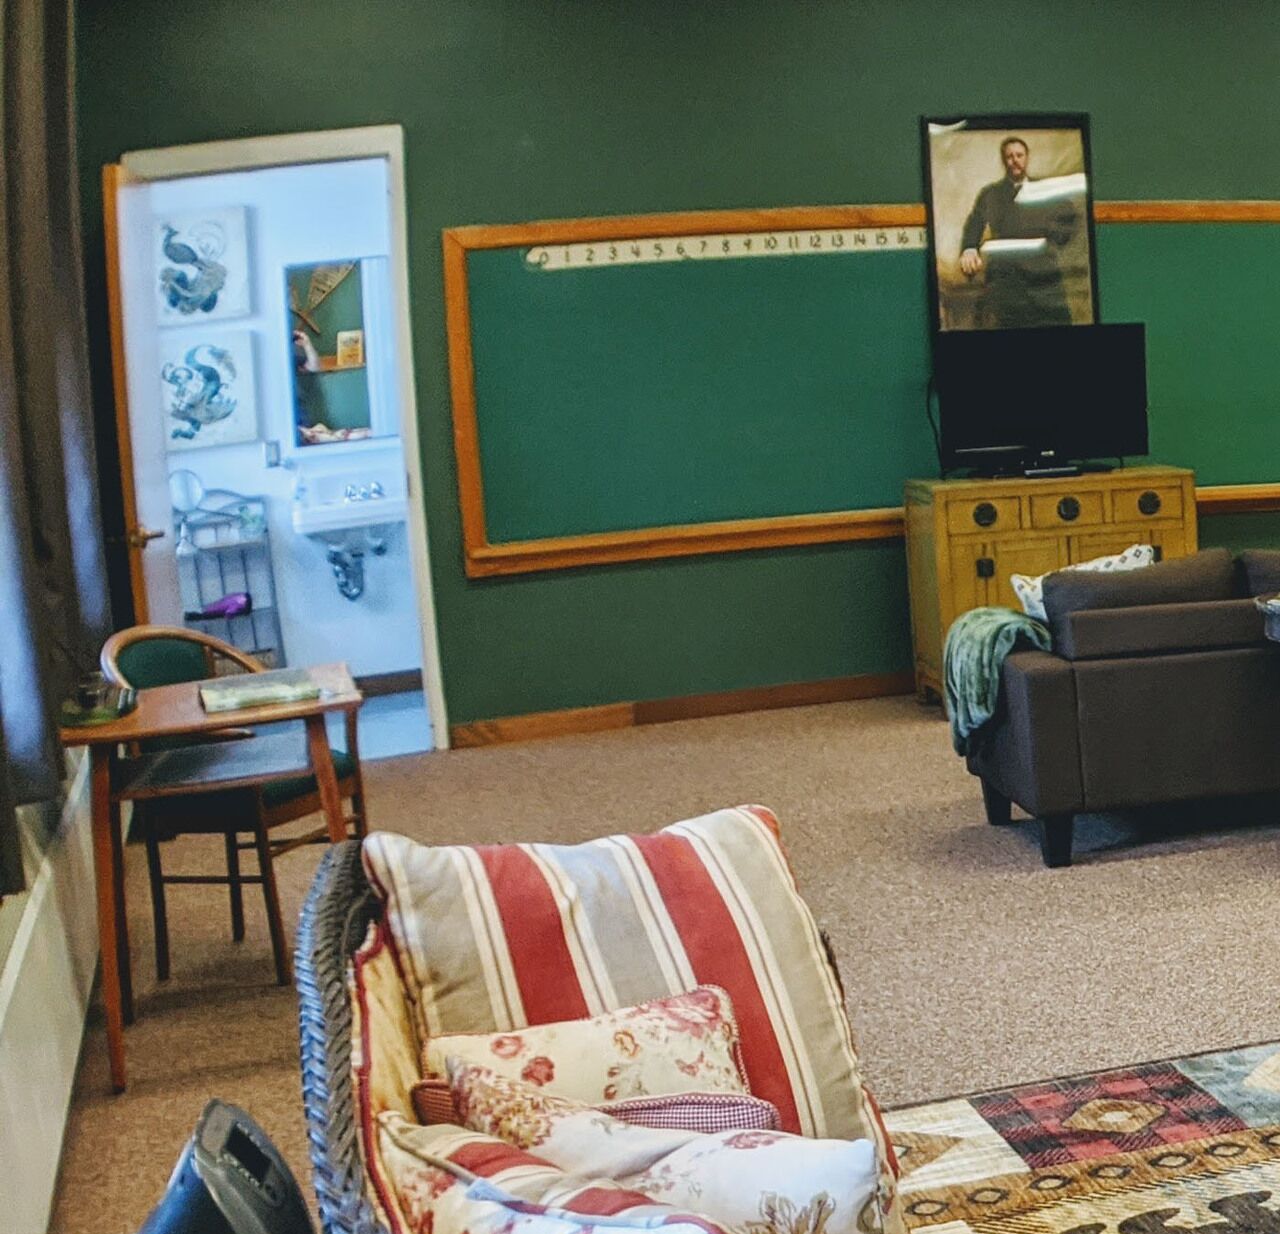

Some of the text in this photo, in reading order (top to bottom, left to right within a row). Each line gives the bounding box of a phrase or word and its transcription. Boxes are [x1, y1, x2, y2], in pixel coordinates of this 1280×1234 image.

[538, 251, 549, 265] 0
[585, 248, 594, 262] 2
[609, 246, 617, 260] 3
[631, 245, 640, 257] 4
[654, 243, 663, 256] 5
[676, 242, 685, 255] 6
[700, 240, 708, 252] 7
[722, 239, 730, 251] 8
[743, 238, 752, 249] 9
[763, 236, 777, 249] 10
[788, 235, 800, 248] 11
[809, 235, 821, 248] 12
[831, 234, 844, 247] 13
[854, 233, 866, 245] 14
[875, 232, 888, 245] 15
[897, 231, 909, 244] 16
